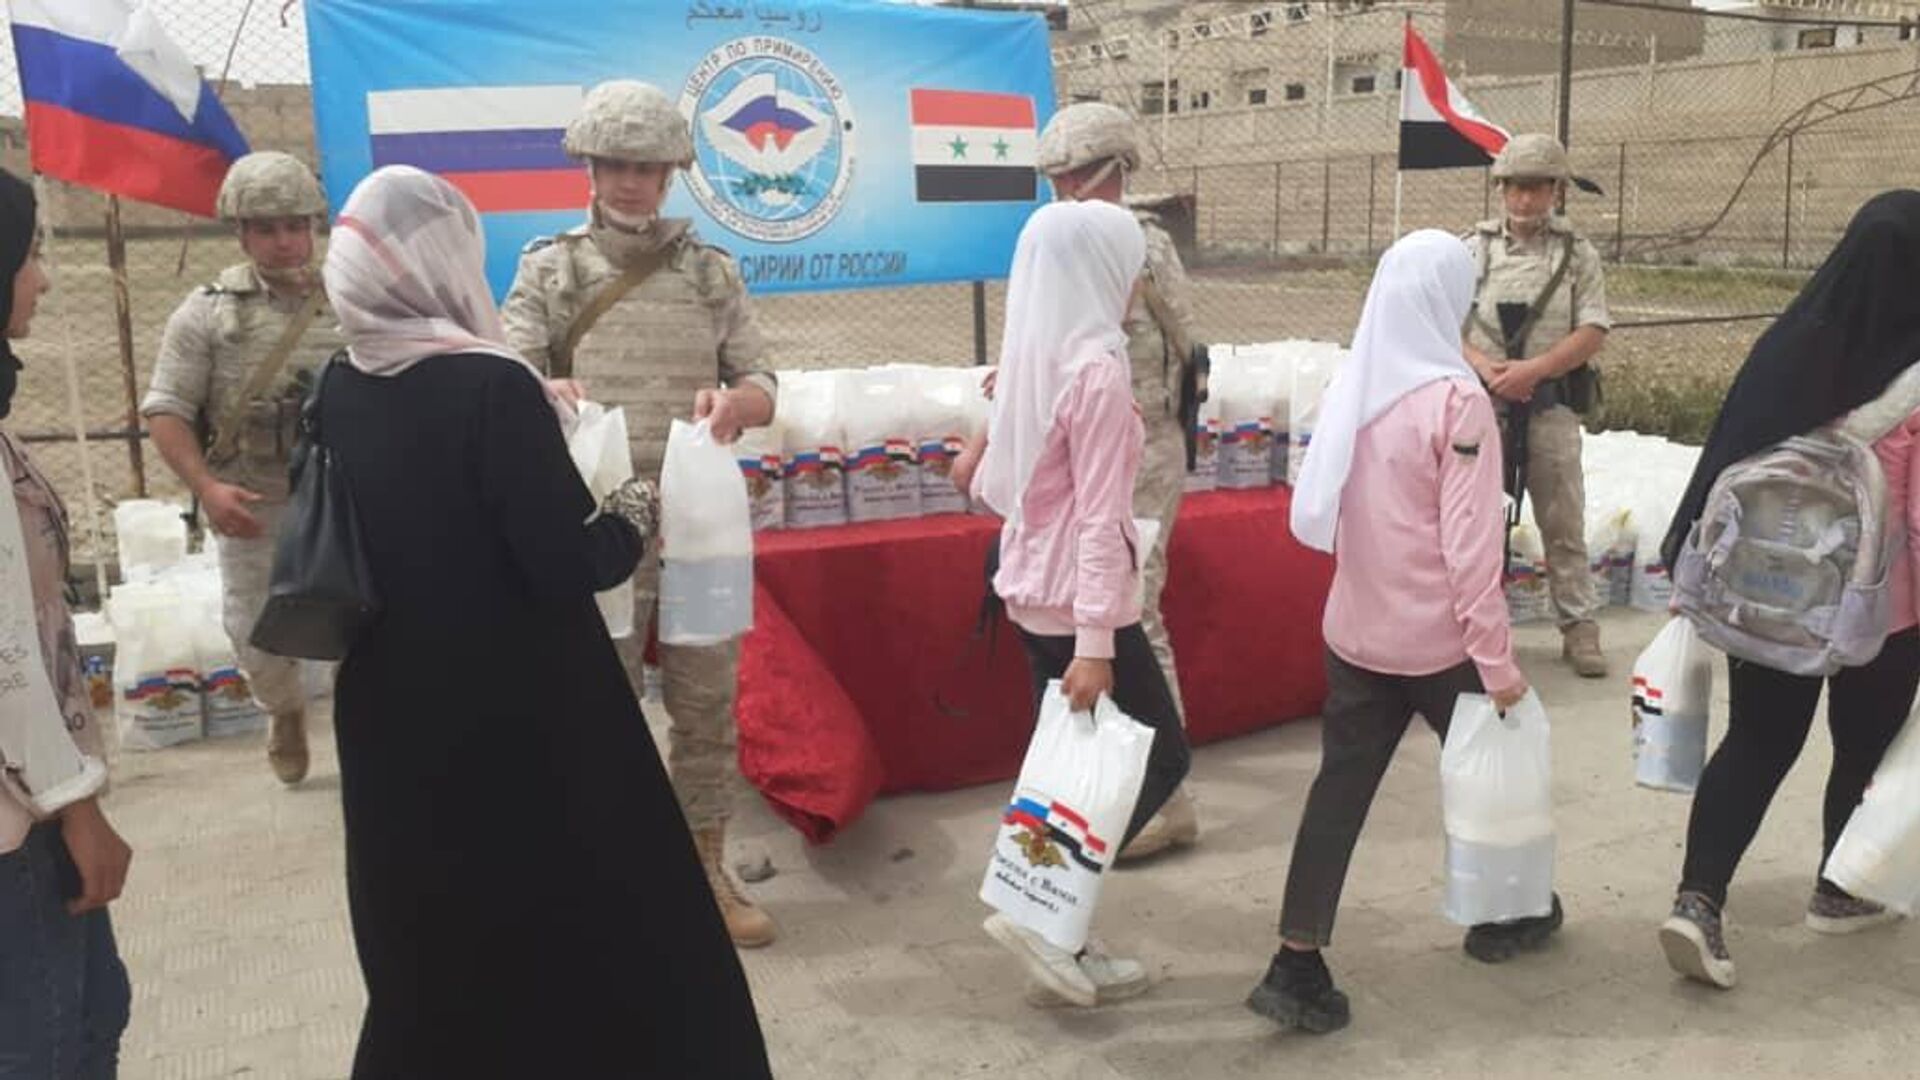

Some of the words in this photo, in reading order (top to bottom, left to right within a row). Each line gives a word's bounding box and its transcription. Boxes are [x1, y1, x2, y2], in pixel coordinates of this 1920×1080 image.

[686, 1, 744, 31] معكم
[754, 3, 821, 33] روسيا
[686, 55, 722, 97] ЦЕНТР
[725, 41, 747, 58] ПО
[753, 38, 843, 100] ПРИМИРЕНИЮ
[740, 253, 805, 284] СИРИИ
[810, 253, 834, 281] ОТ
[838, 251, 907, 277] РОССИИ
